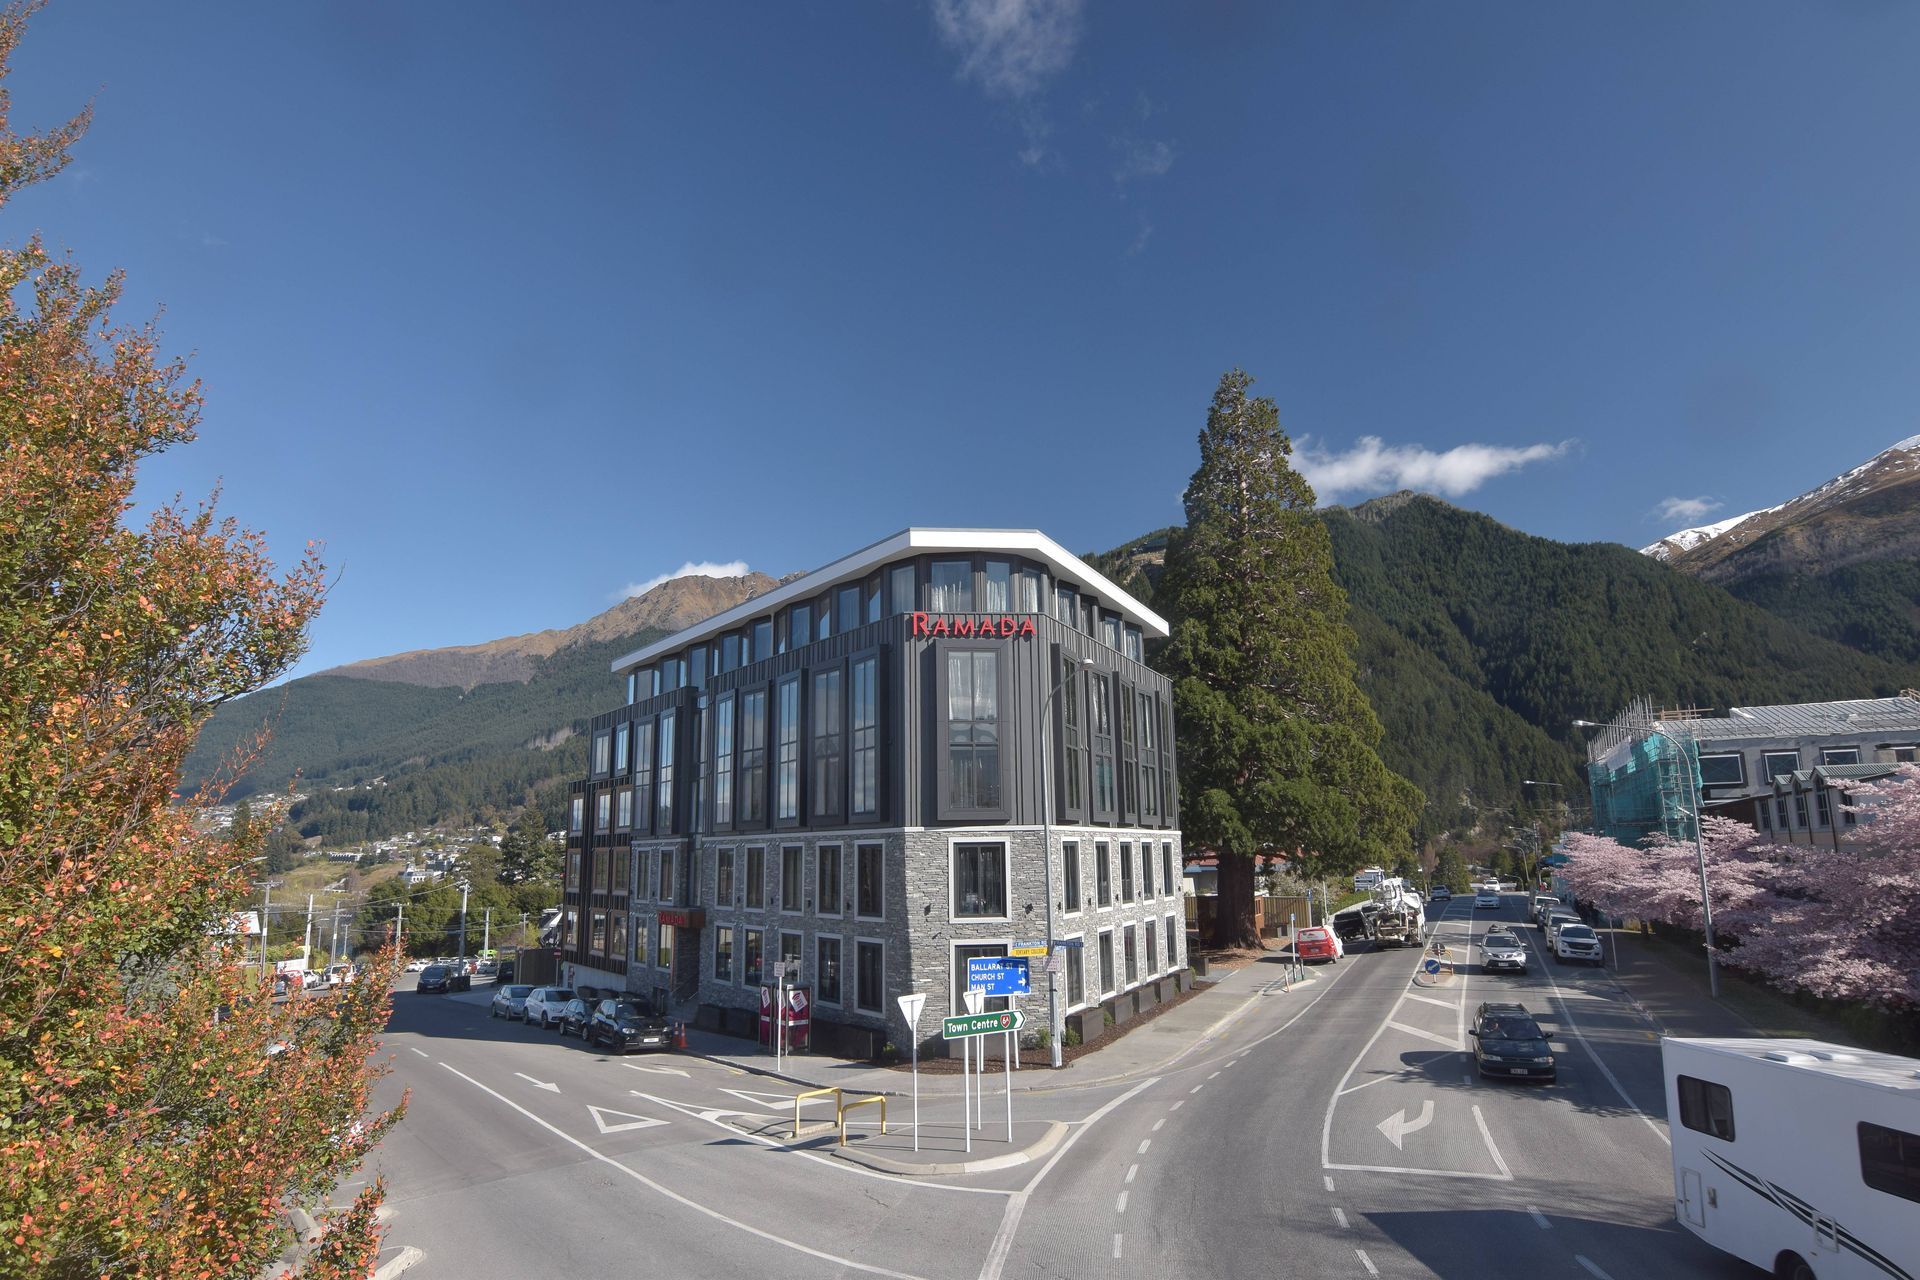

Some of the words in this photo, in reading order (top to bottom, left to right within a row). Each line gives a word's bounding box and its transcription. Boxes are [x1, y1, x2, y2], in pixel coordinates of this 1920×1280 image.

[911, 611, 1036, 636] RAMADA
[971, 963, 1003, 971] BALLARAT
[971, 973, 996, 981] CHURCH
[997, 972, 1005, 980] ST
[947, 1023, 968, 1033] Town
[971, 1019, 998, 1030] Centre
